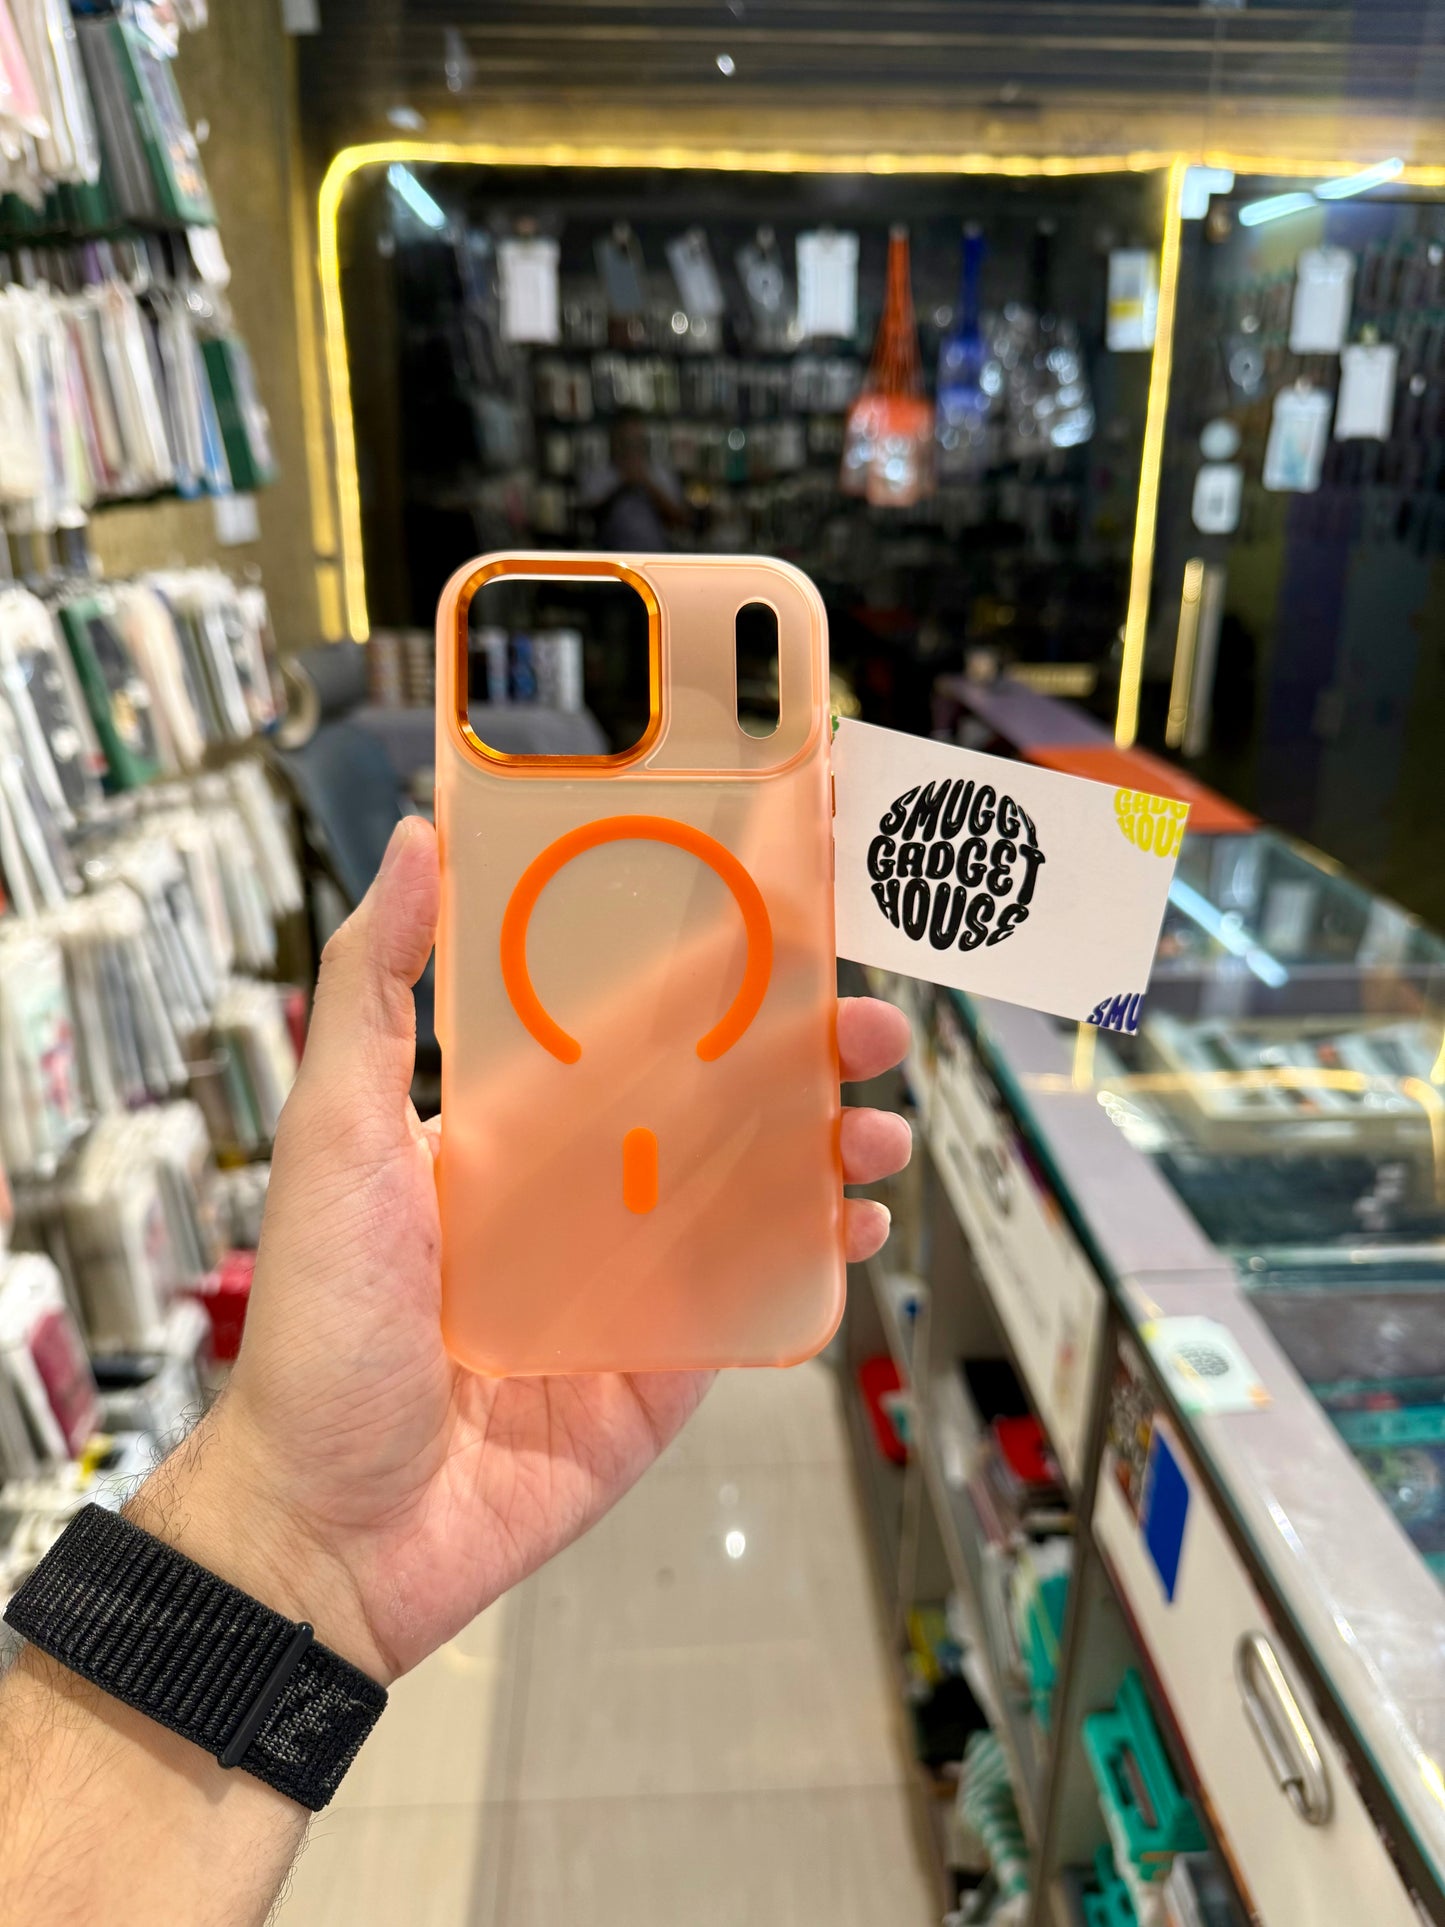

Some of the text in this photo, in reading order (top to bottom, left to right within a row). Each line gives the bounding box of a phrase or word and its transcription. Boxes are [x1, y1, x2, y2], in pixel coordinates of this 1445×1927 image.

[879, 778, 1038, 848] SMUGGY
[867, 834, 1046, 905] GADGET
[871, 878, 1029, 952] HOUSE
